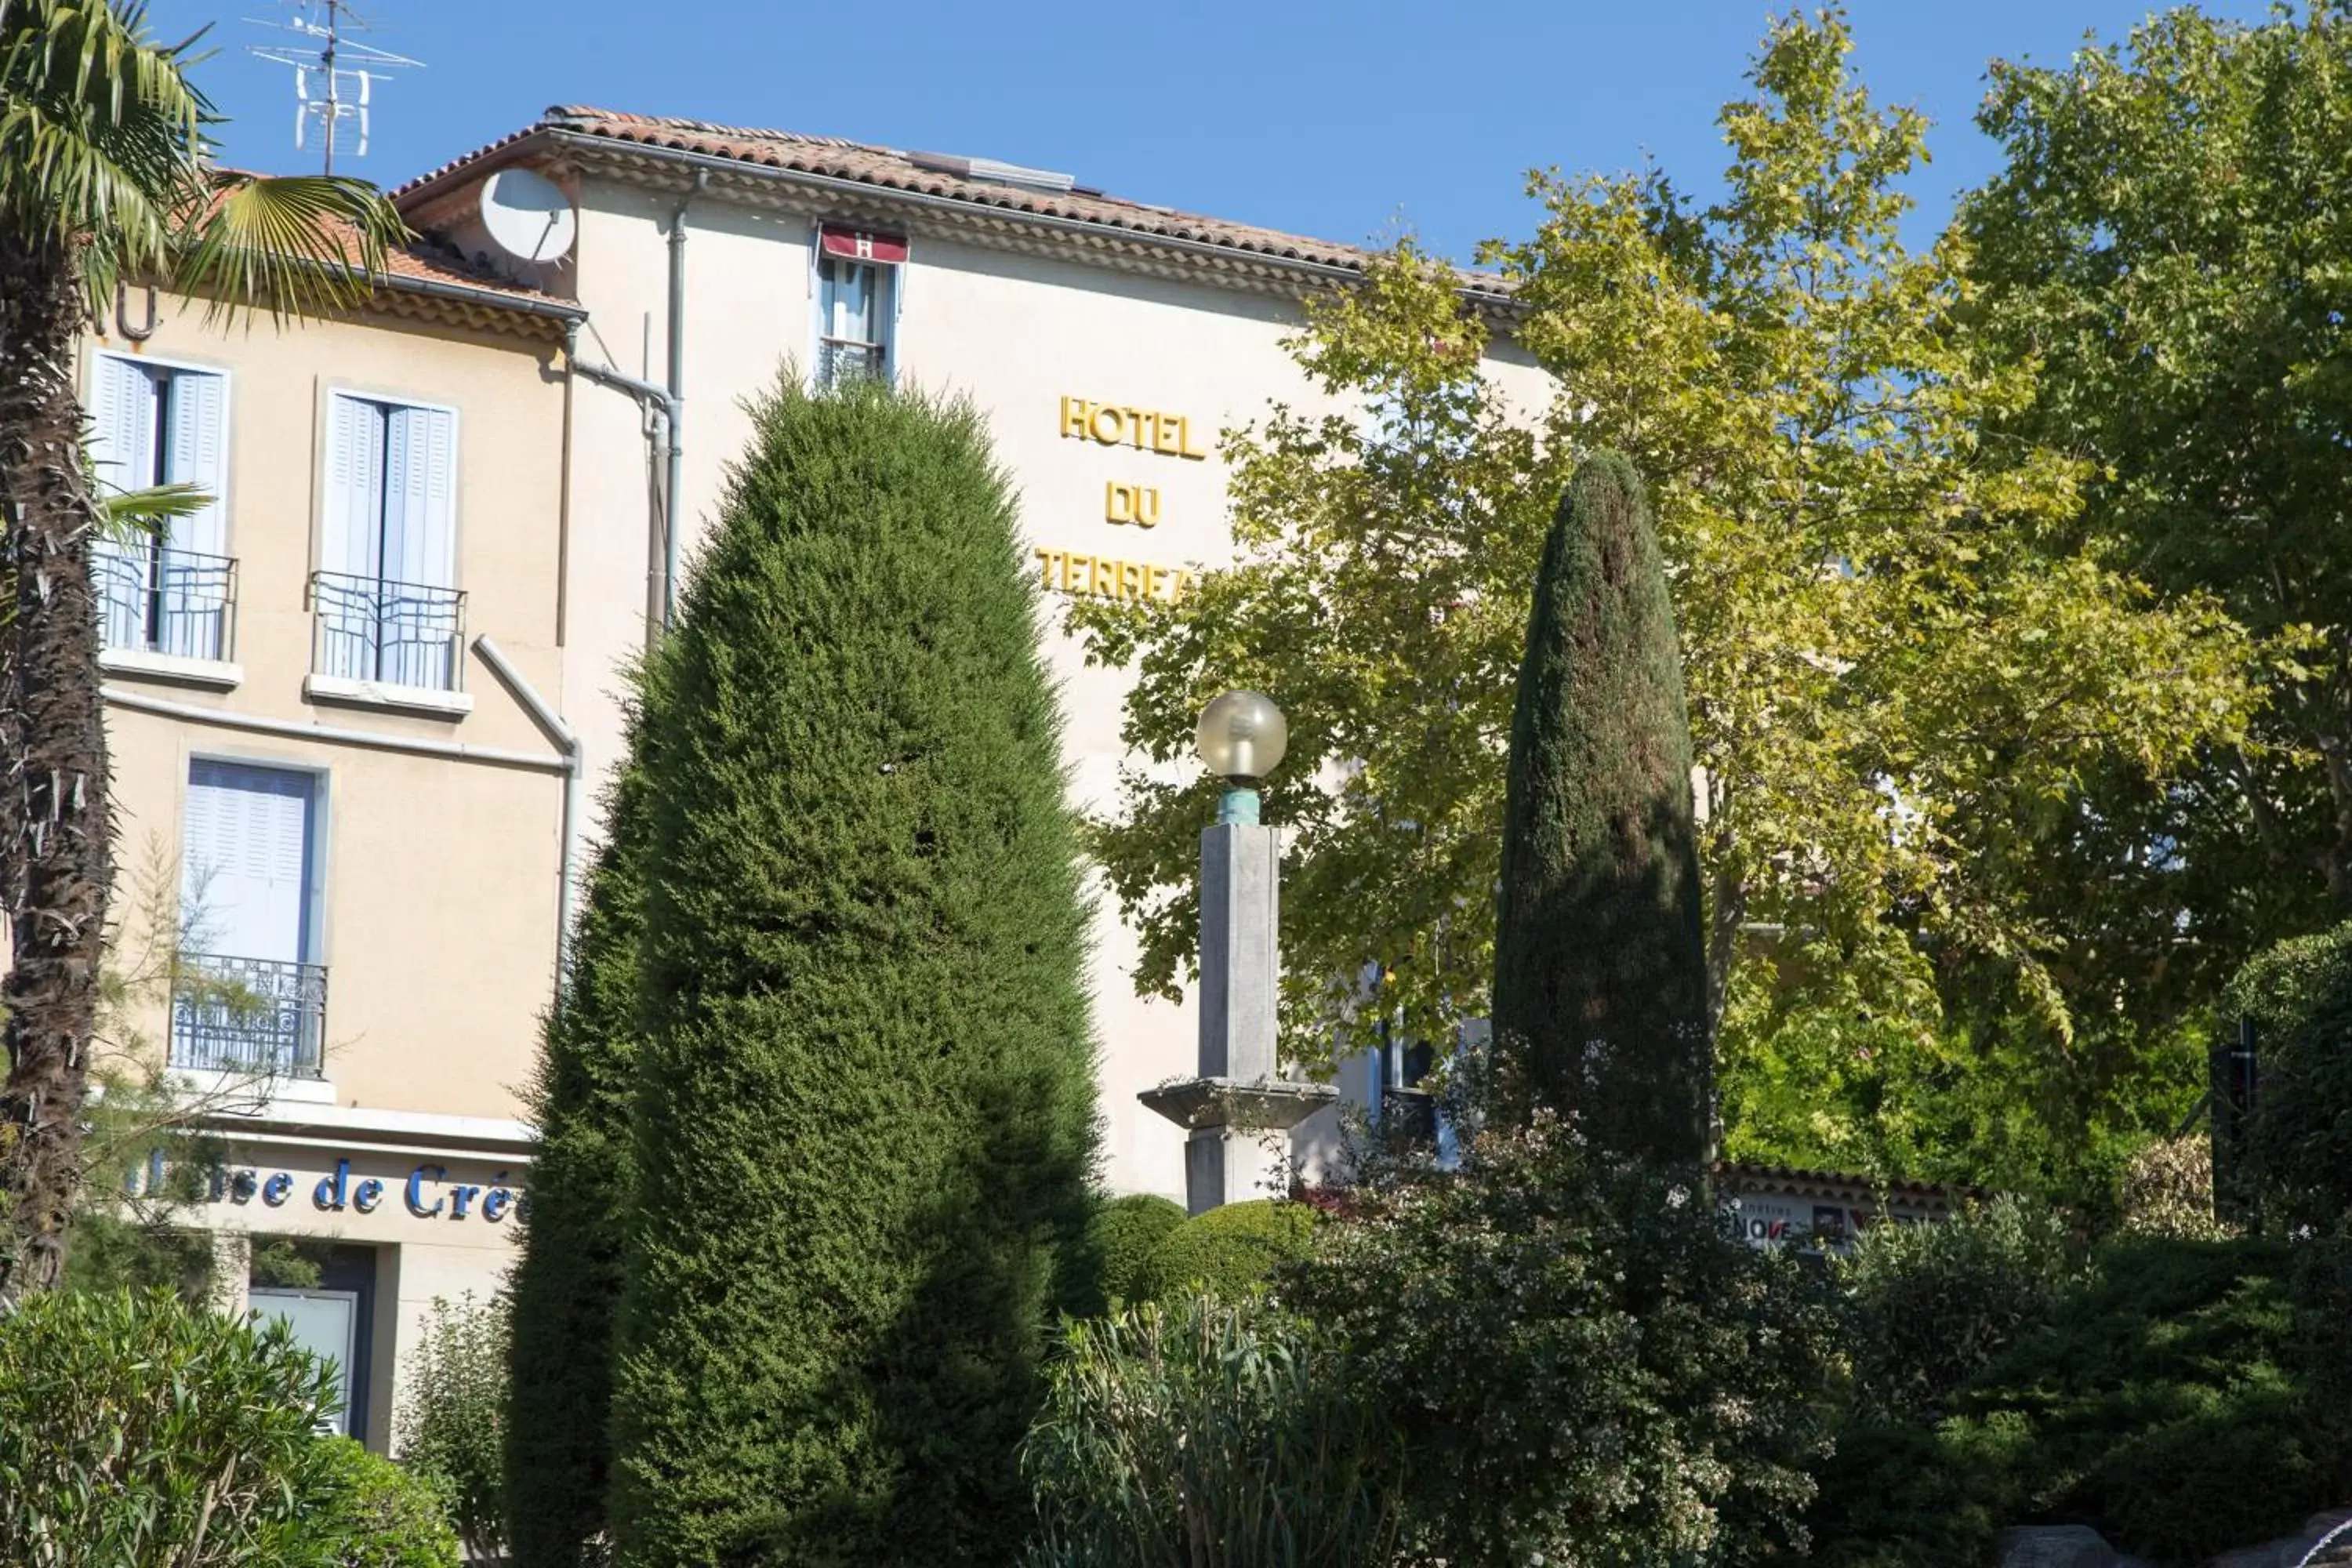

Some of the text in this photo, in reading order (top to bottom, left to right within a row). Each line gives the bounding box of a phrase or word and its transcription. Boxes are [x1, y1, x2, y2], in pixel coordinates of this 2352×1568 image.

[1060, 395, 1207, 461] HOTEL
[1105, 481, 1161, 529] DU
[312, 1156, 385, 1214] de
